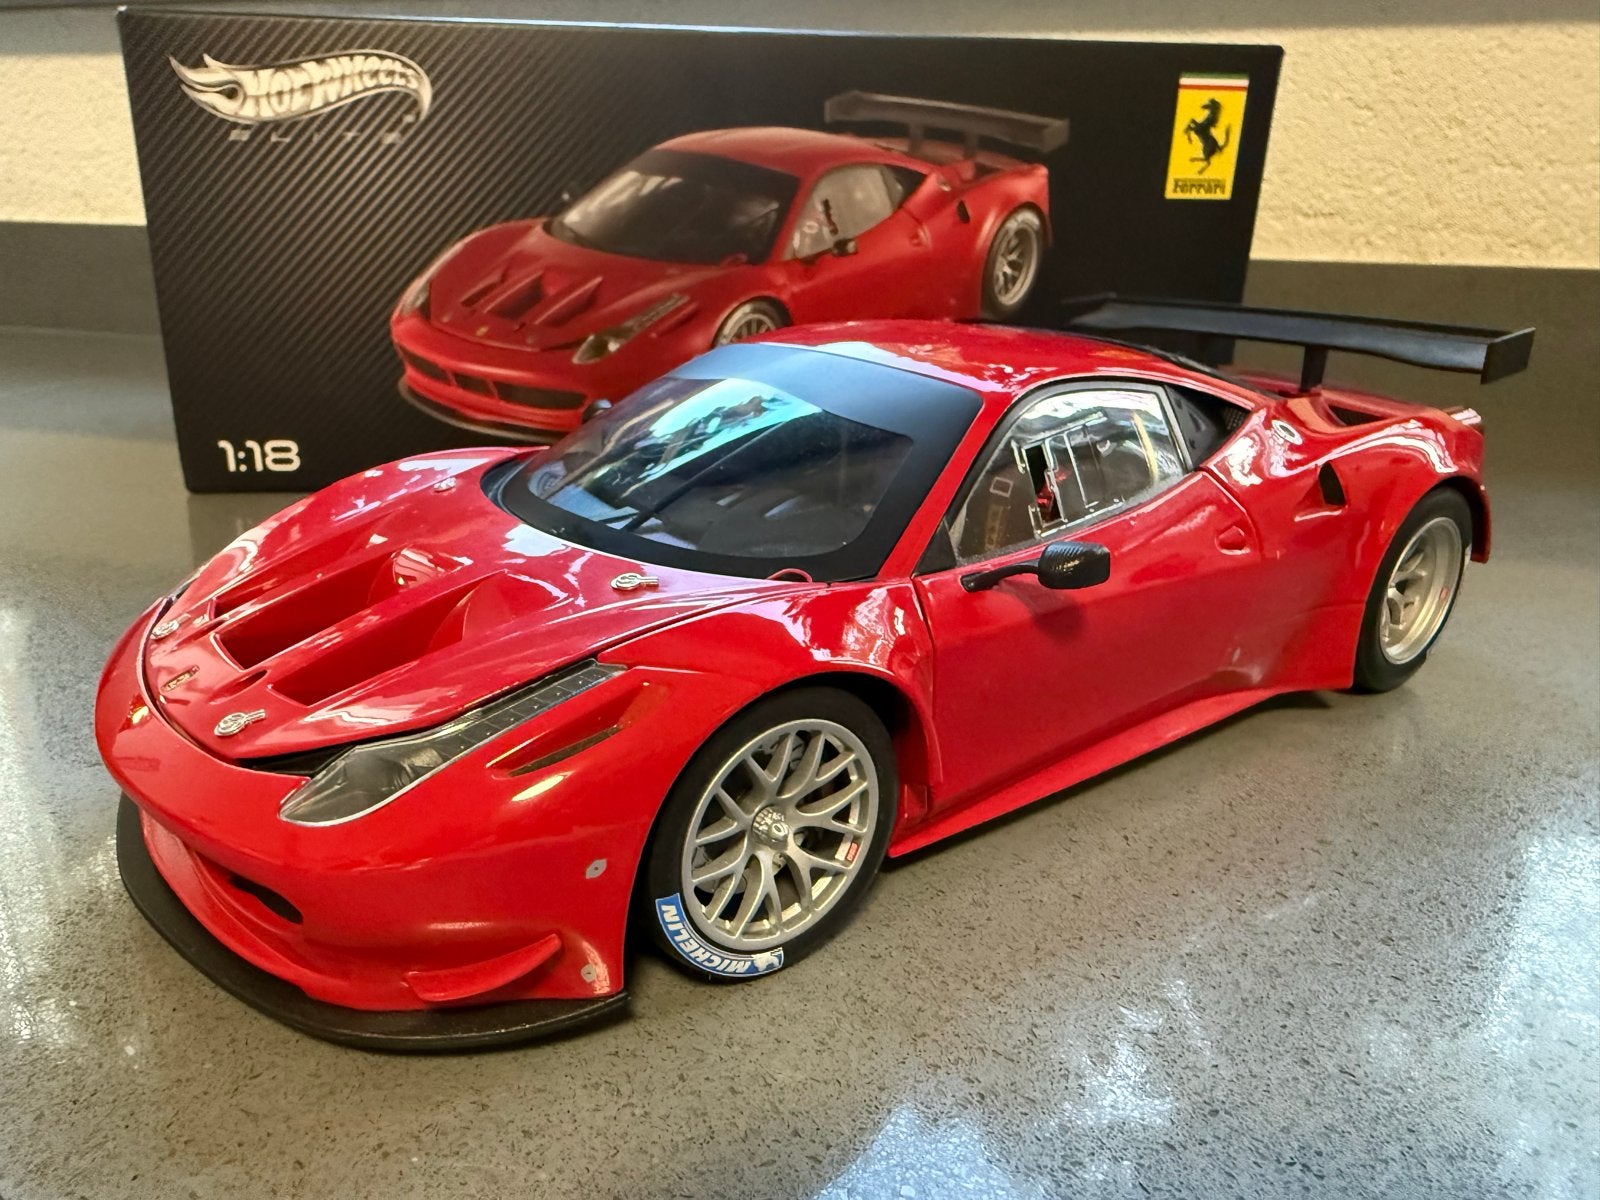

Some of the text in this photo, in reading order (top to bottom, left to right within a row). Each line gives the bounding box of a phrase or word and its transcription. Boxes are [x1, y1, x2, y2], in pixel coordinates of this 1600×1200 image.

[1172, 178, 1226, 195] Ferrari
[217, 439, 301, 472] 1:18
[661, 904, 751, 973] MICHELIN
